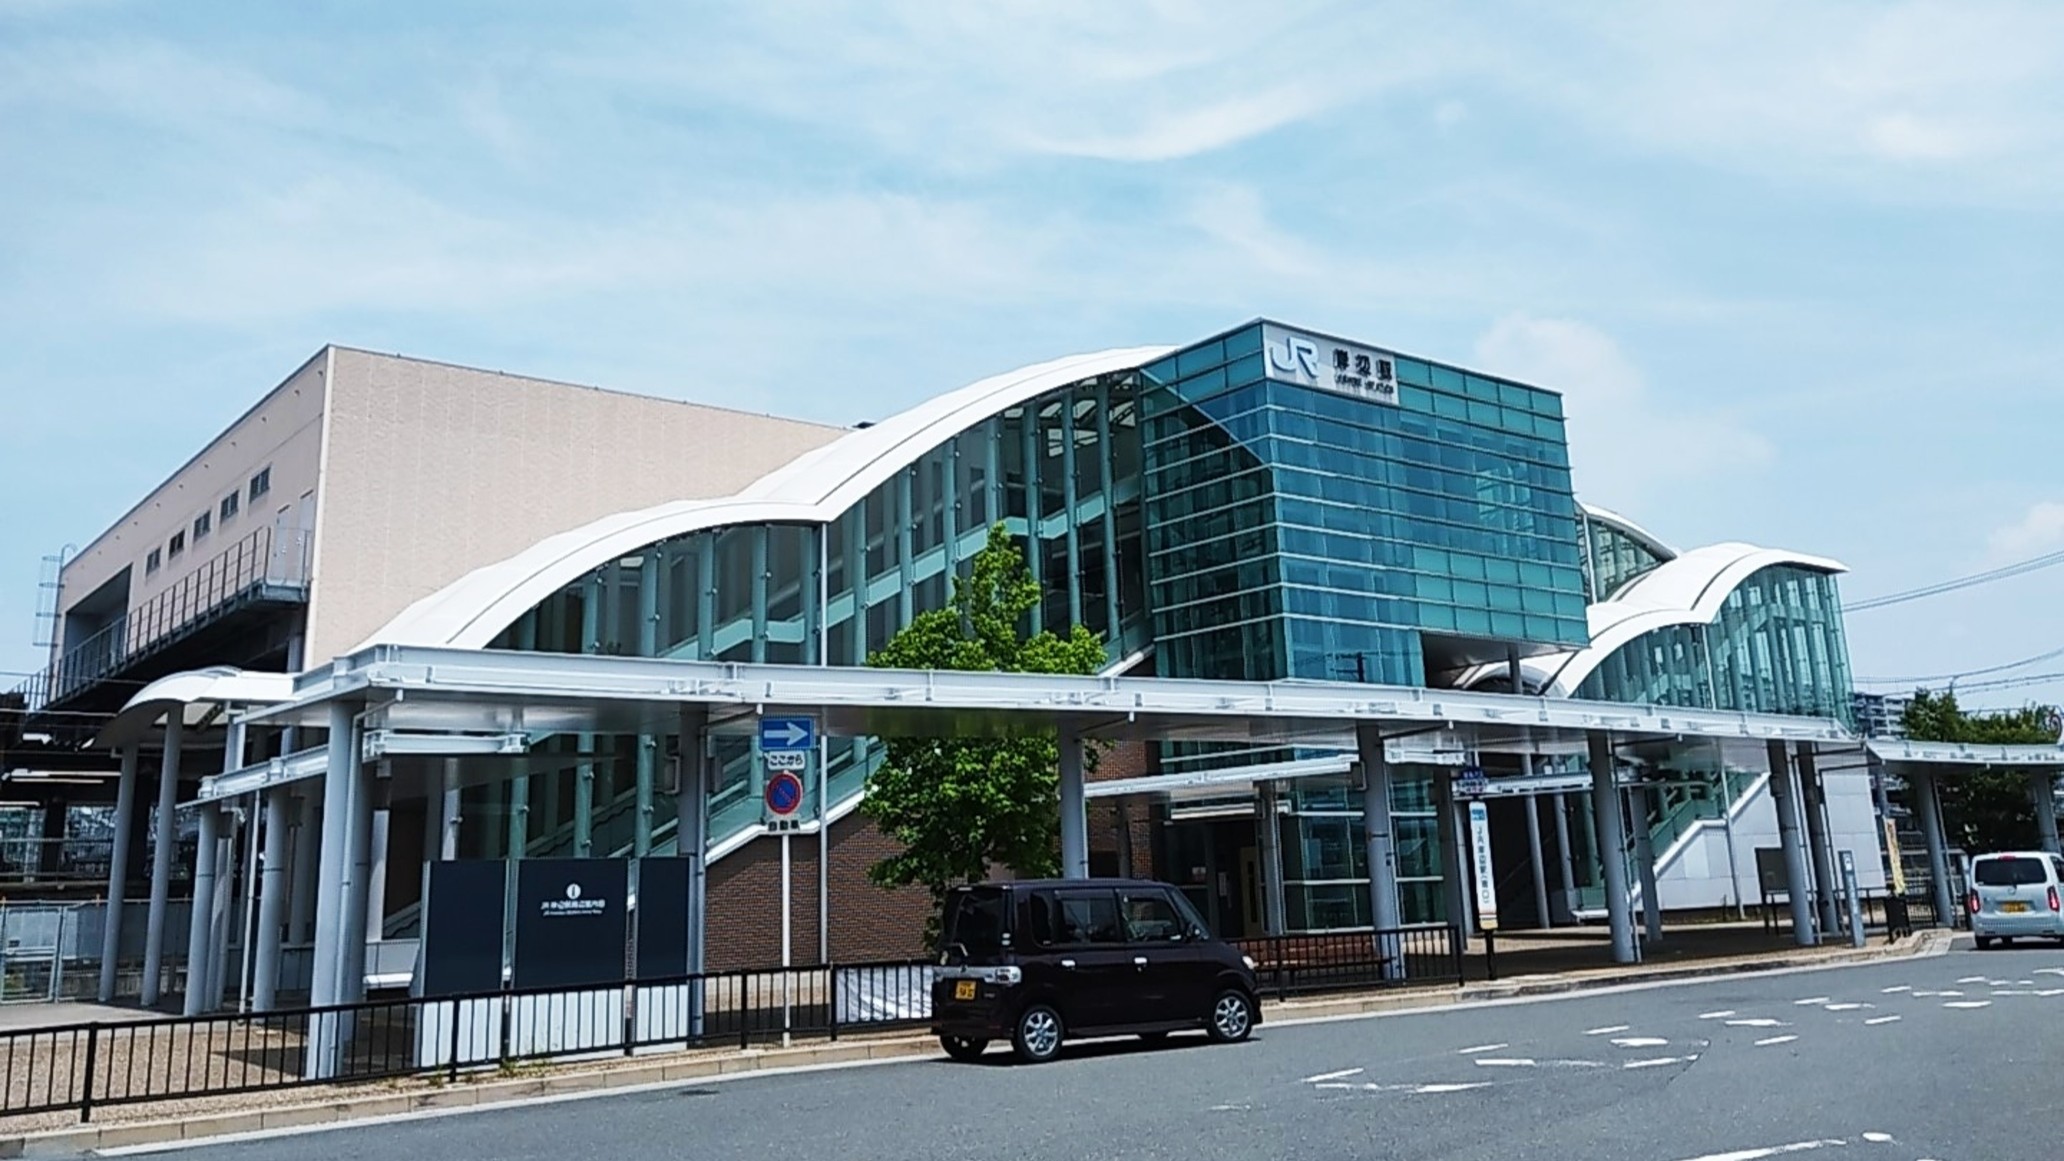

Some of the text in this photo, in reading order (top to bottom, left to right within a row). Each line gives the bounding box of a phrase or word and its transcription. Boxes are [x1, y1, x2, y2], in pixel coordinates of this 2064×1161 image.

[1269, 336, 1319, 379] JR
[769, 753, 803, 766] ここから
